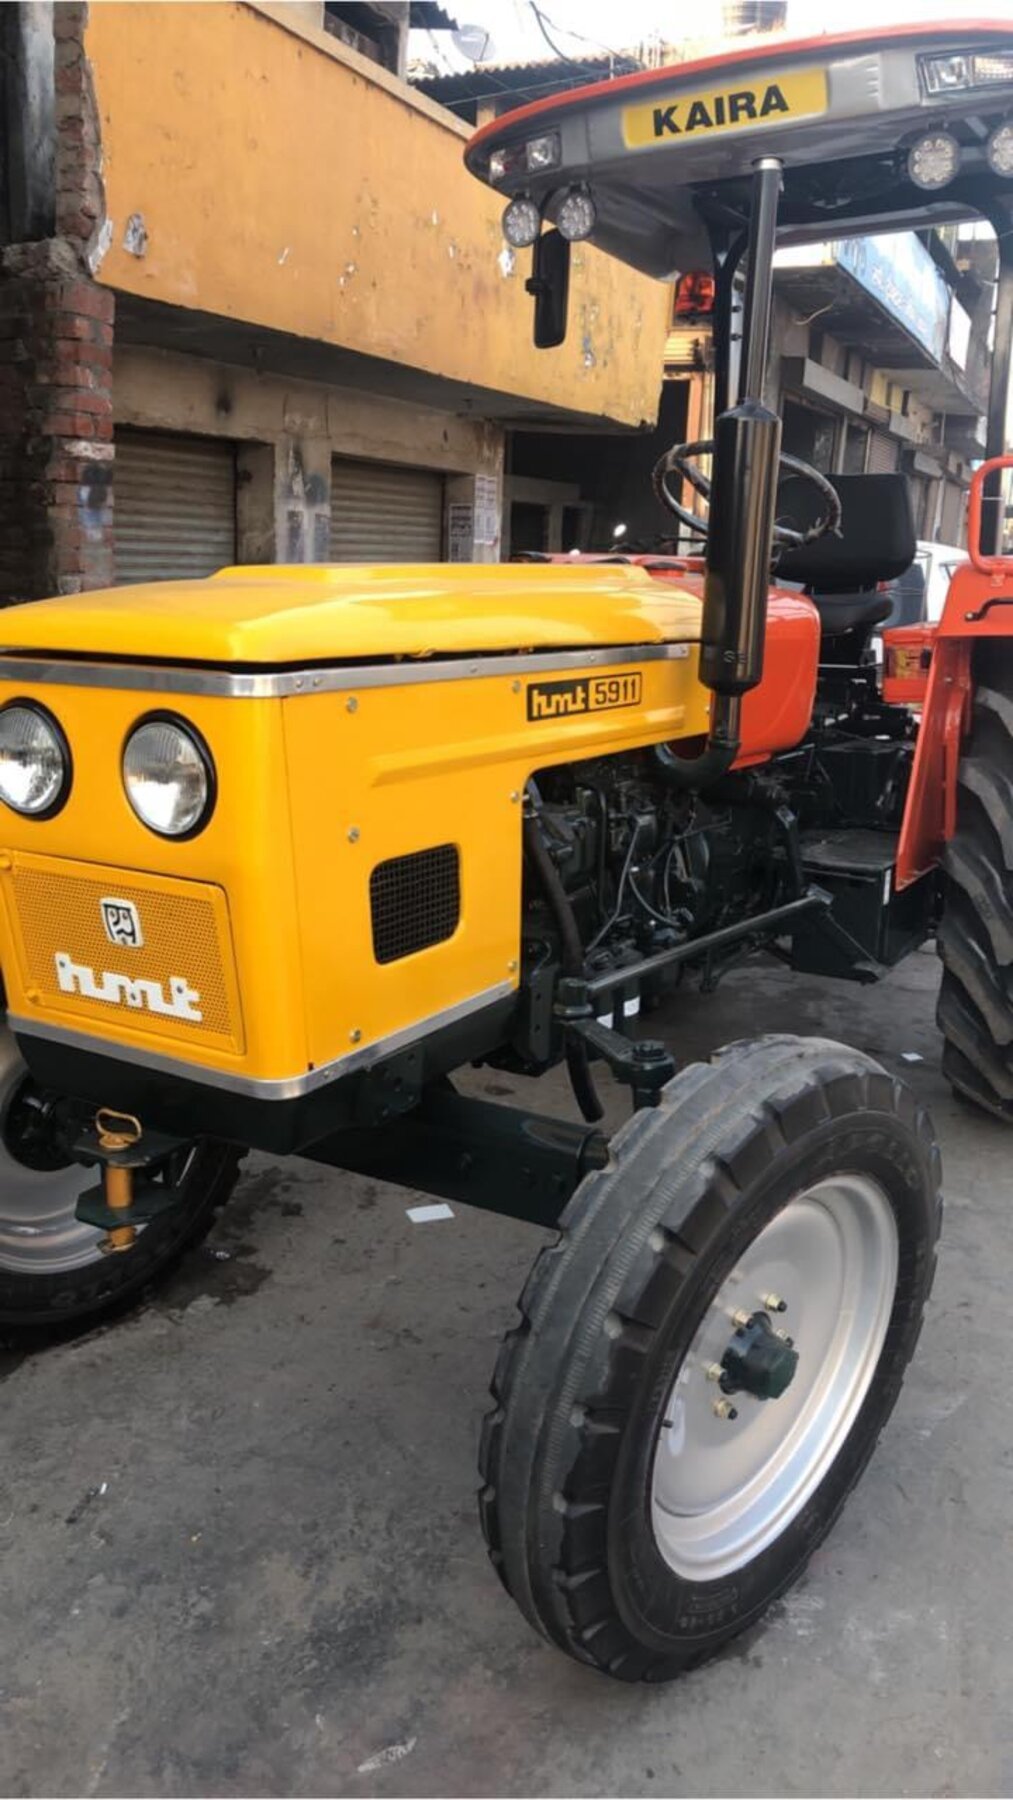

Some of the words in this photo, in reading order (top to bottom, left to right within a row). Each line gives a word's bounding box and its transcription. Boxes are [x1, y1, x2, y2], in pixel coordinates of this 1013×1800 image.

[653, 84, 789, 136] KAIRA
[532, 686, 586, 718] hmt
[595, 678, 636, 705] 5911
[55, 952, 203, 1022] hmt
